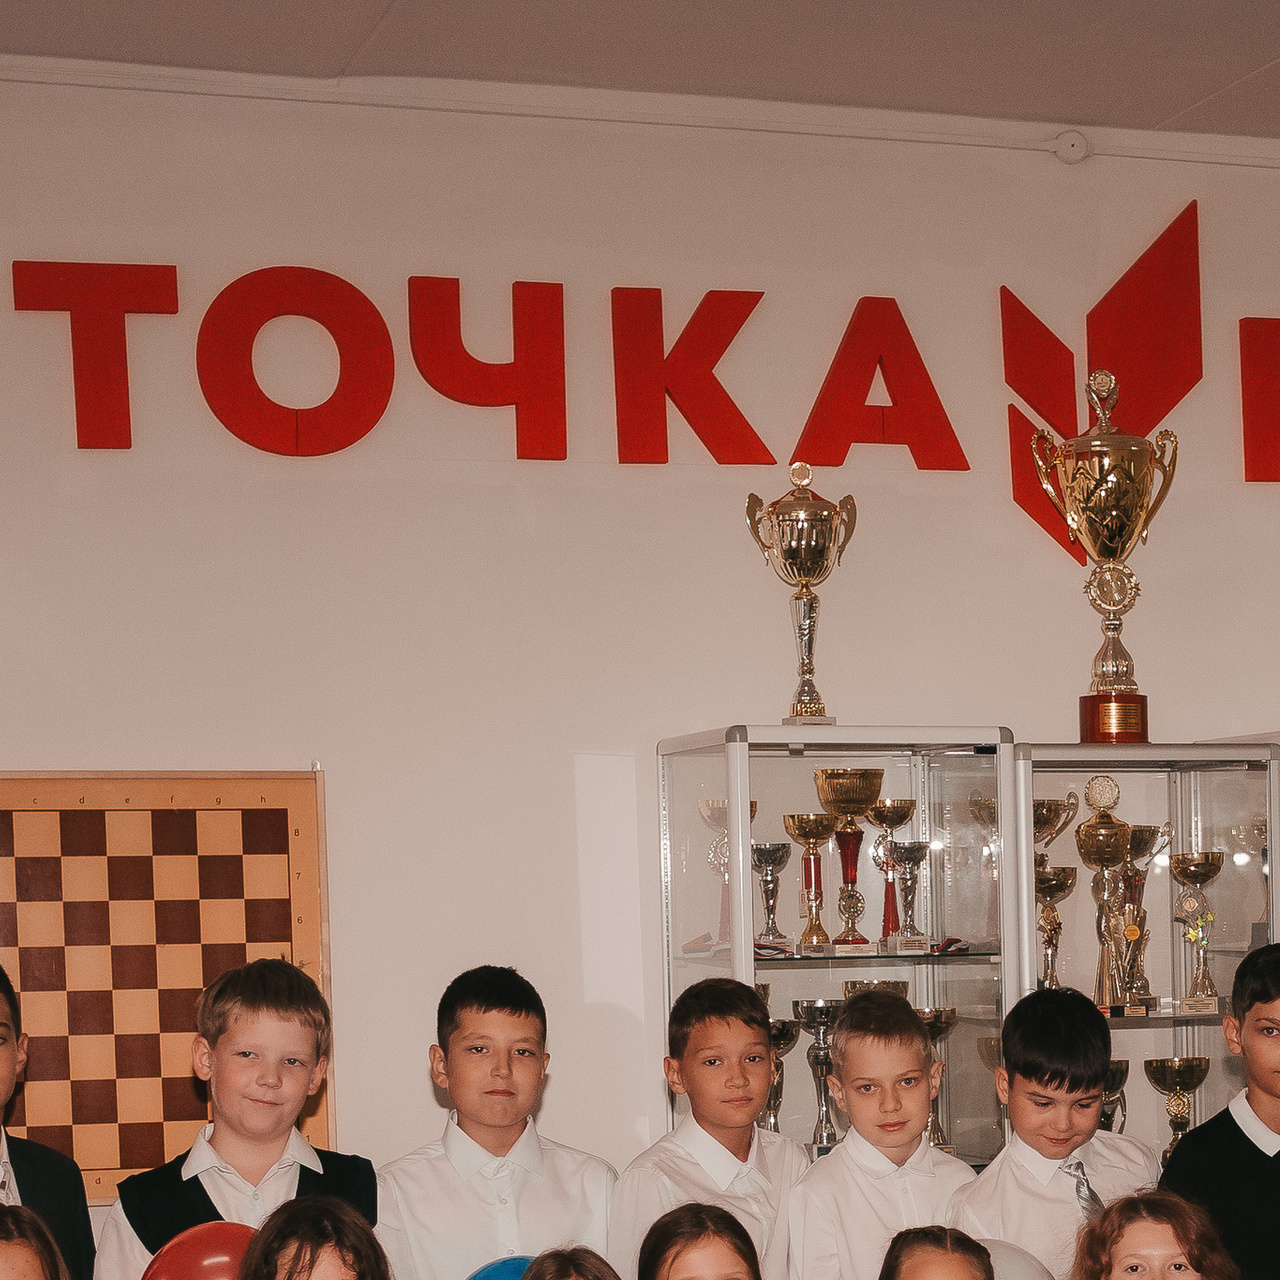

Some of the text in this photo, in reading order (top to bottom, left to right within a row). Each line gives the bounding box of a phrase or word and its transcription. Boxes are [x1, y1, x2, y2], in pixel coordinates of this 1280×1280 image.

[12, 259, 971, 472] ТОЧКА
[79, 796, 85, 804] d
[170, 795, 175, 803] f
[215, 797, 222, 806] g
[294, 829, 300, 837] 8
[296, 872, 301, 880] 7
[297, 916, 303, 924] 6
